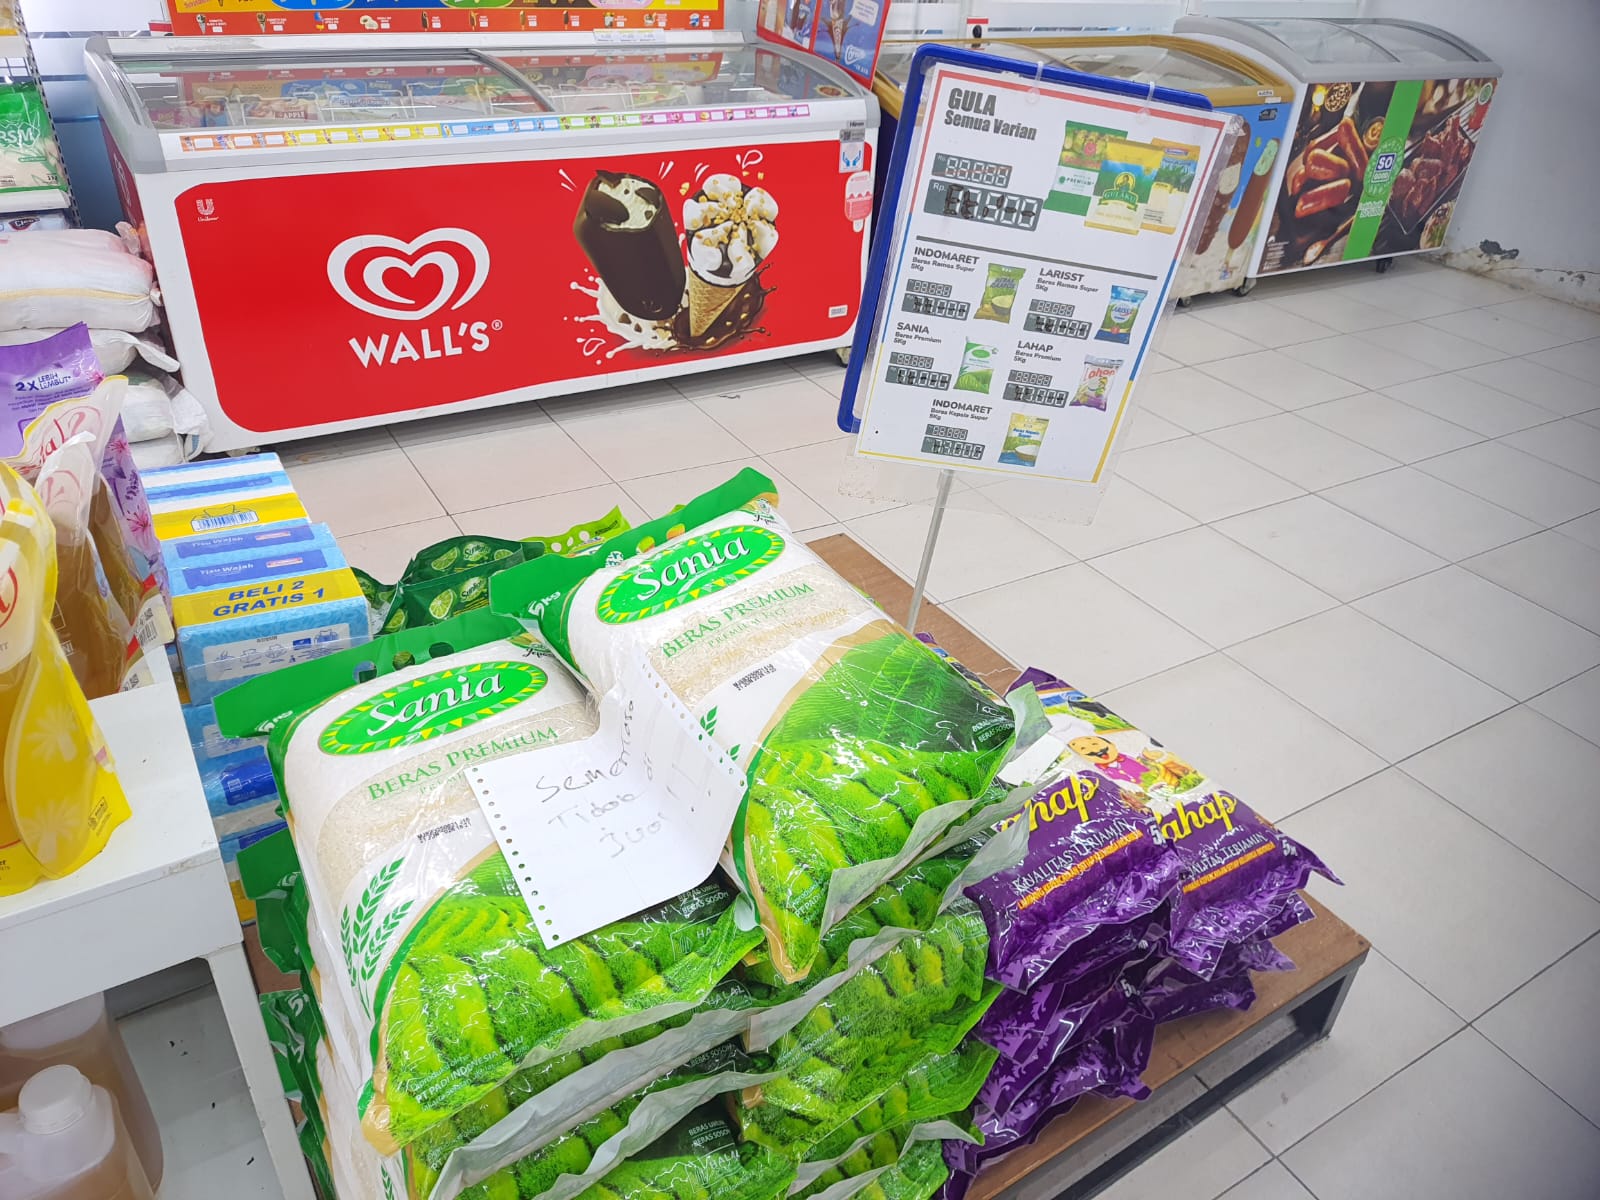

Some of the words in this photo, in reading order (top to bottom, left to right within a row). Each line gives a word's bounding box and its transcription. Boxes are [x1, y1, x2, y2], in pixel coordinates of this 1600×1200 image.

[948, 88, 997, 116] GULA
[944, 110, 991, 132] Semua
[993, 119, 1037, 140] Varian
[1378, 156, 1393, 169] SO
[933, 183, 946, 192] Rp.
[914, 246, 980, 265] INDOMARET
[1039, 268, 1085, 282] LARISST
[897, 322, 930, 334] SANIA
[348, 321, 490, 369] WALL'S
[914, 333, 942, 344] Premium
[1017, 341, 1054, 353] LAHAP
[1034, 353, 1062, 362] Premium
[38, 373, 58, 383] LEBIH
[932, 399, 992, 414] INDOMARET
[222, 563, 254, 573] Wajah
[632, 537, 750, 600] Sania
[228, 583, 284, 600] BELI
[292, 581, 305, 590] 2
[213, 593, 304, 617] GRATIS
[313, 588, 325, 598] 1
[660, 615, 721, 659] BERAS
[721, 582, 814, 621] PREMIUM
[366, 673, 505, 737] Sania
[367, 760, 442, 801] BERAS
[445, 727, 560, 770] PREMIUM
[1012, 850, 1073, 892] KUALITAS
[415, 1092, 428, 1103] PT
[429, 1077, 451, 1098] PADI
[450, 1051, 498, 1081] INDONESIA
[499, 1036, 524, 1052] MAJU
[688, 1123, 709, 1136] BERAS
